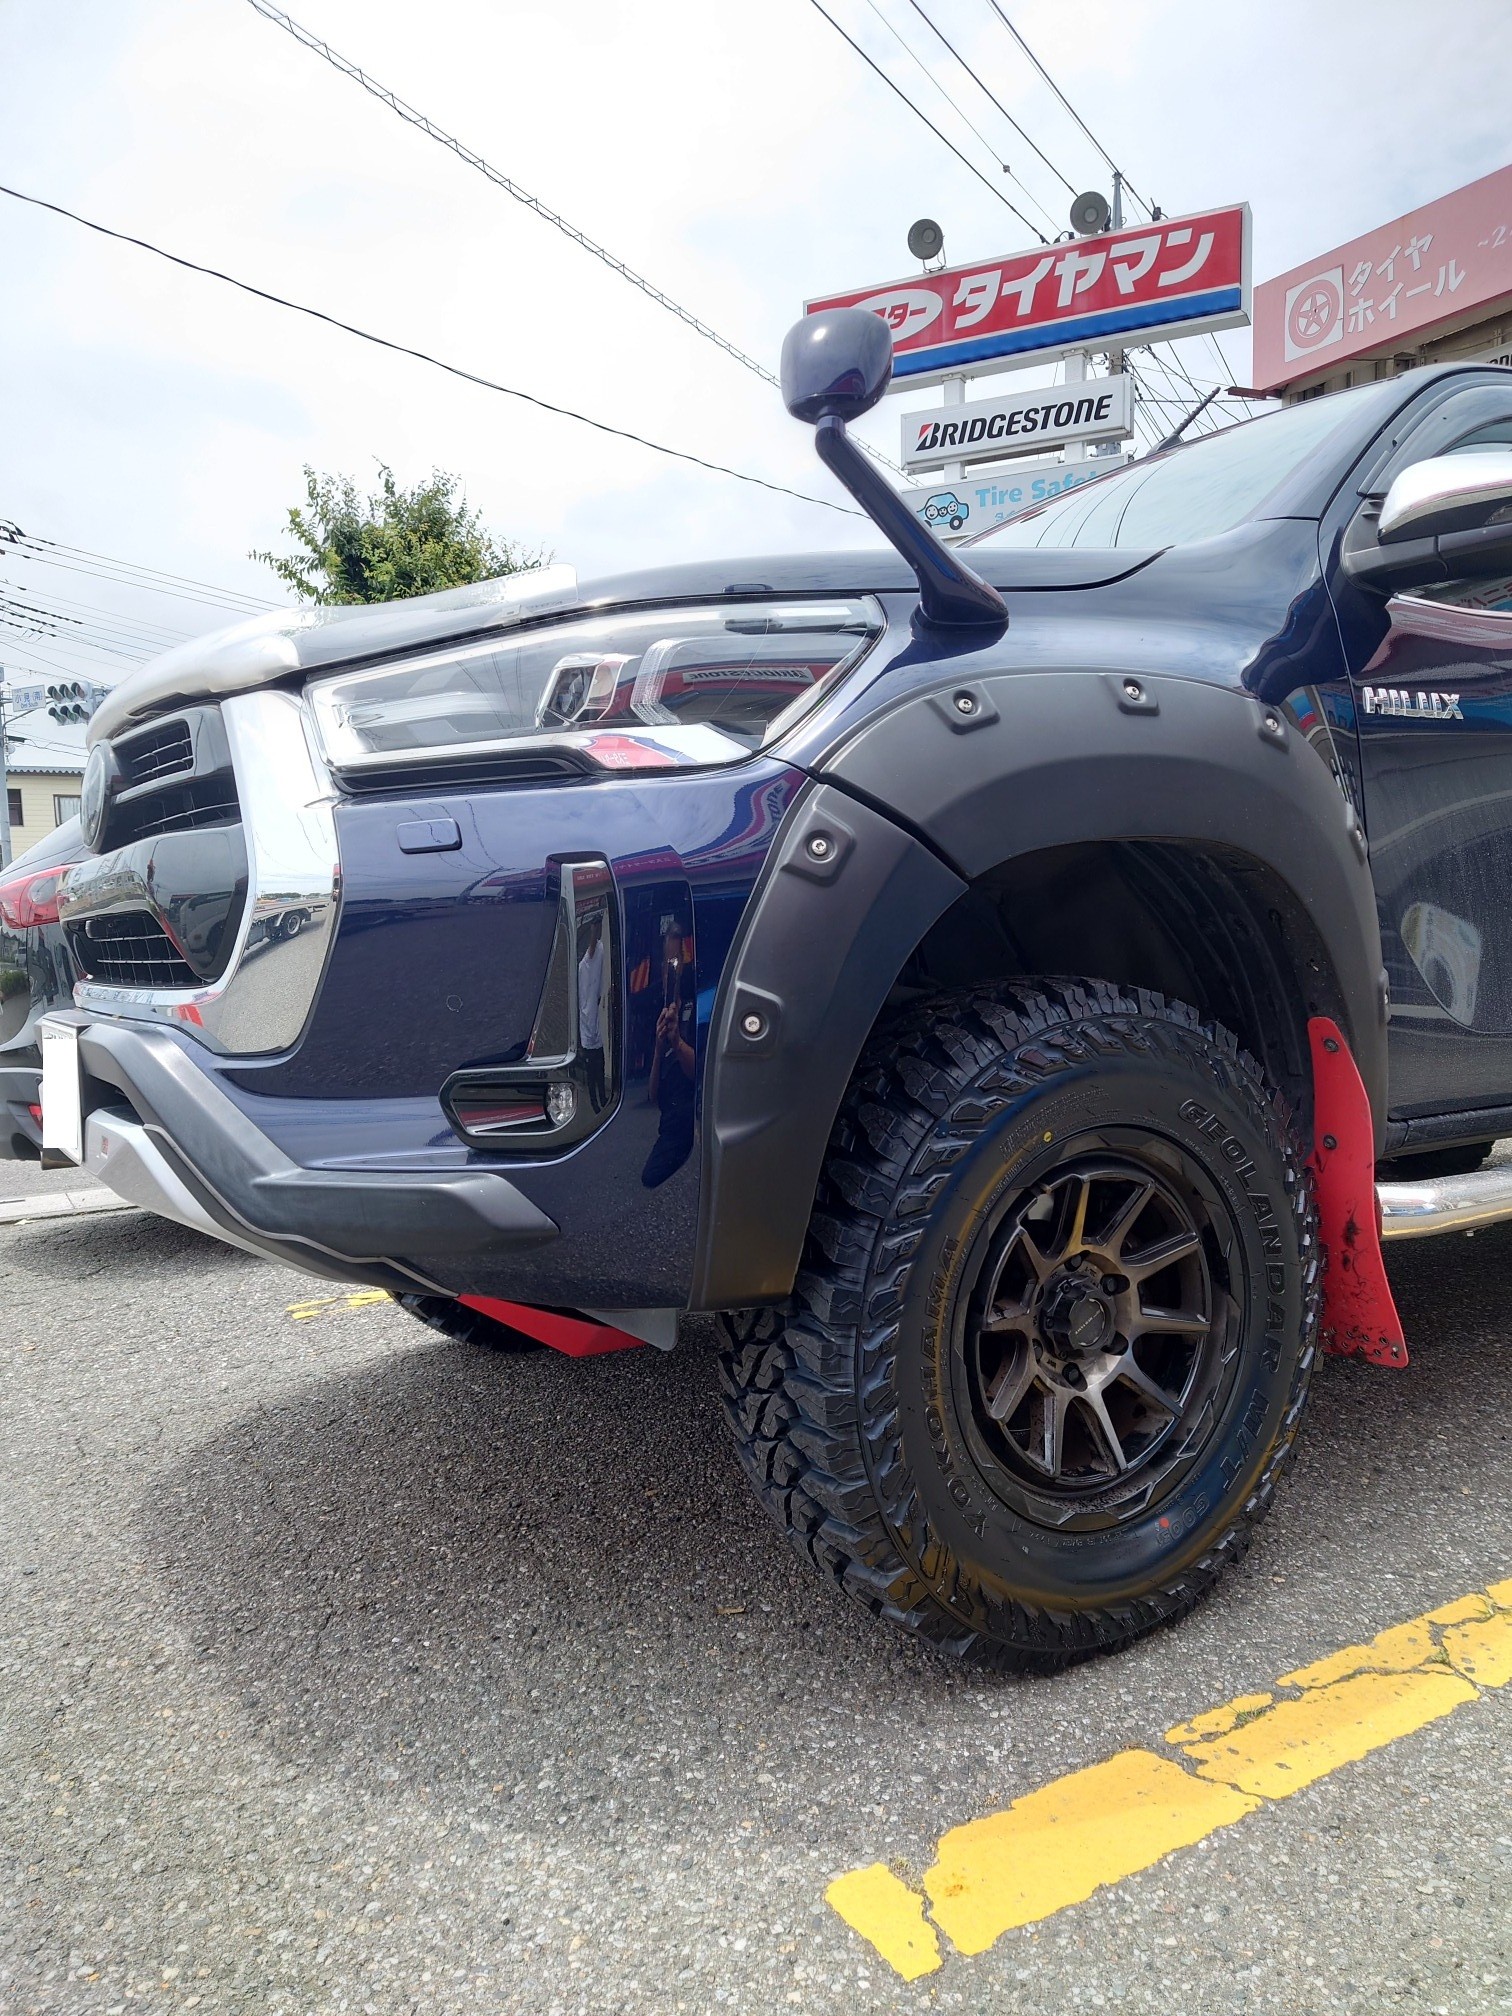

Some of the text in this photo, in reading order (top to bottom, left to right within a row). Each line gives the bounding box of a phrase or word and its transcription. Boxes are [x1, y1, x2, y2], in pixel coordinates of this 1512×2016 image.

[872, 227, 1216, 330] ター タイヤマン
[1347, 258, 1467, 334] ホイール
[1348, 233, 1435, 298] タイヤ
[915, 394, 1114, 452] BRIDGESTONE
[975, 485, 1022, 508] Tire
[1363, 686, 1465, 720] HILUX
[1178, 1099, 1287, 1375] GEOLANDAR
[924, 1235, 988, 1540] YOKOHAMA
[1220, 1389, 1270, 1492] M/T
